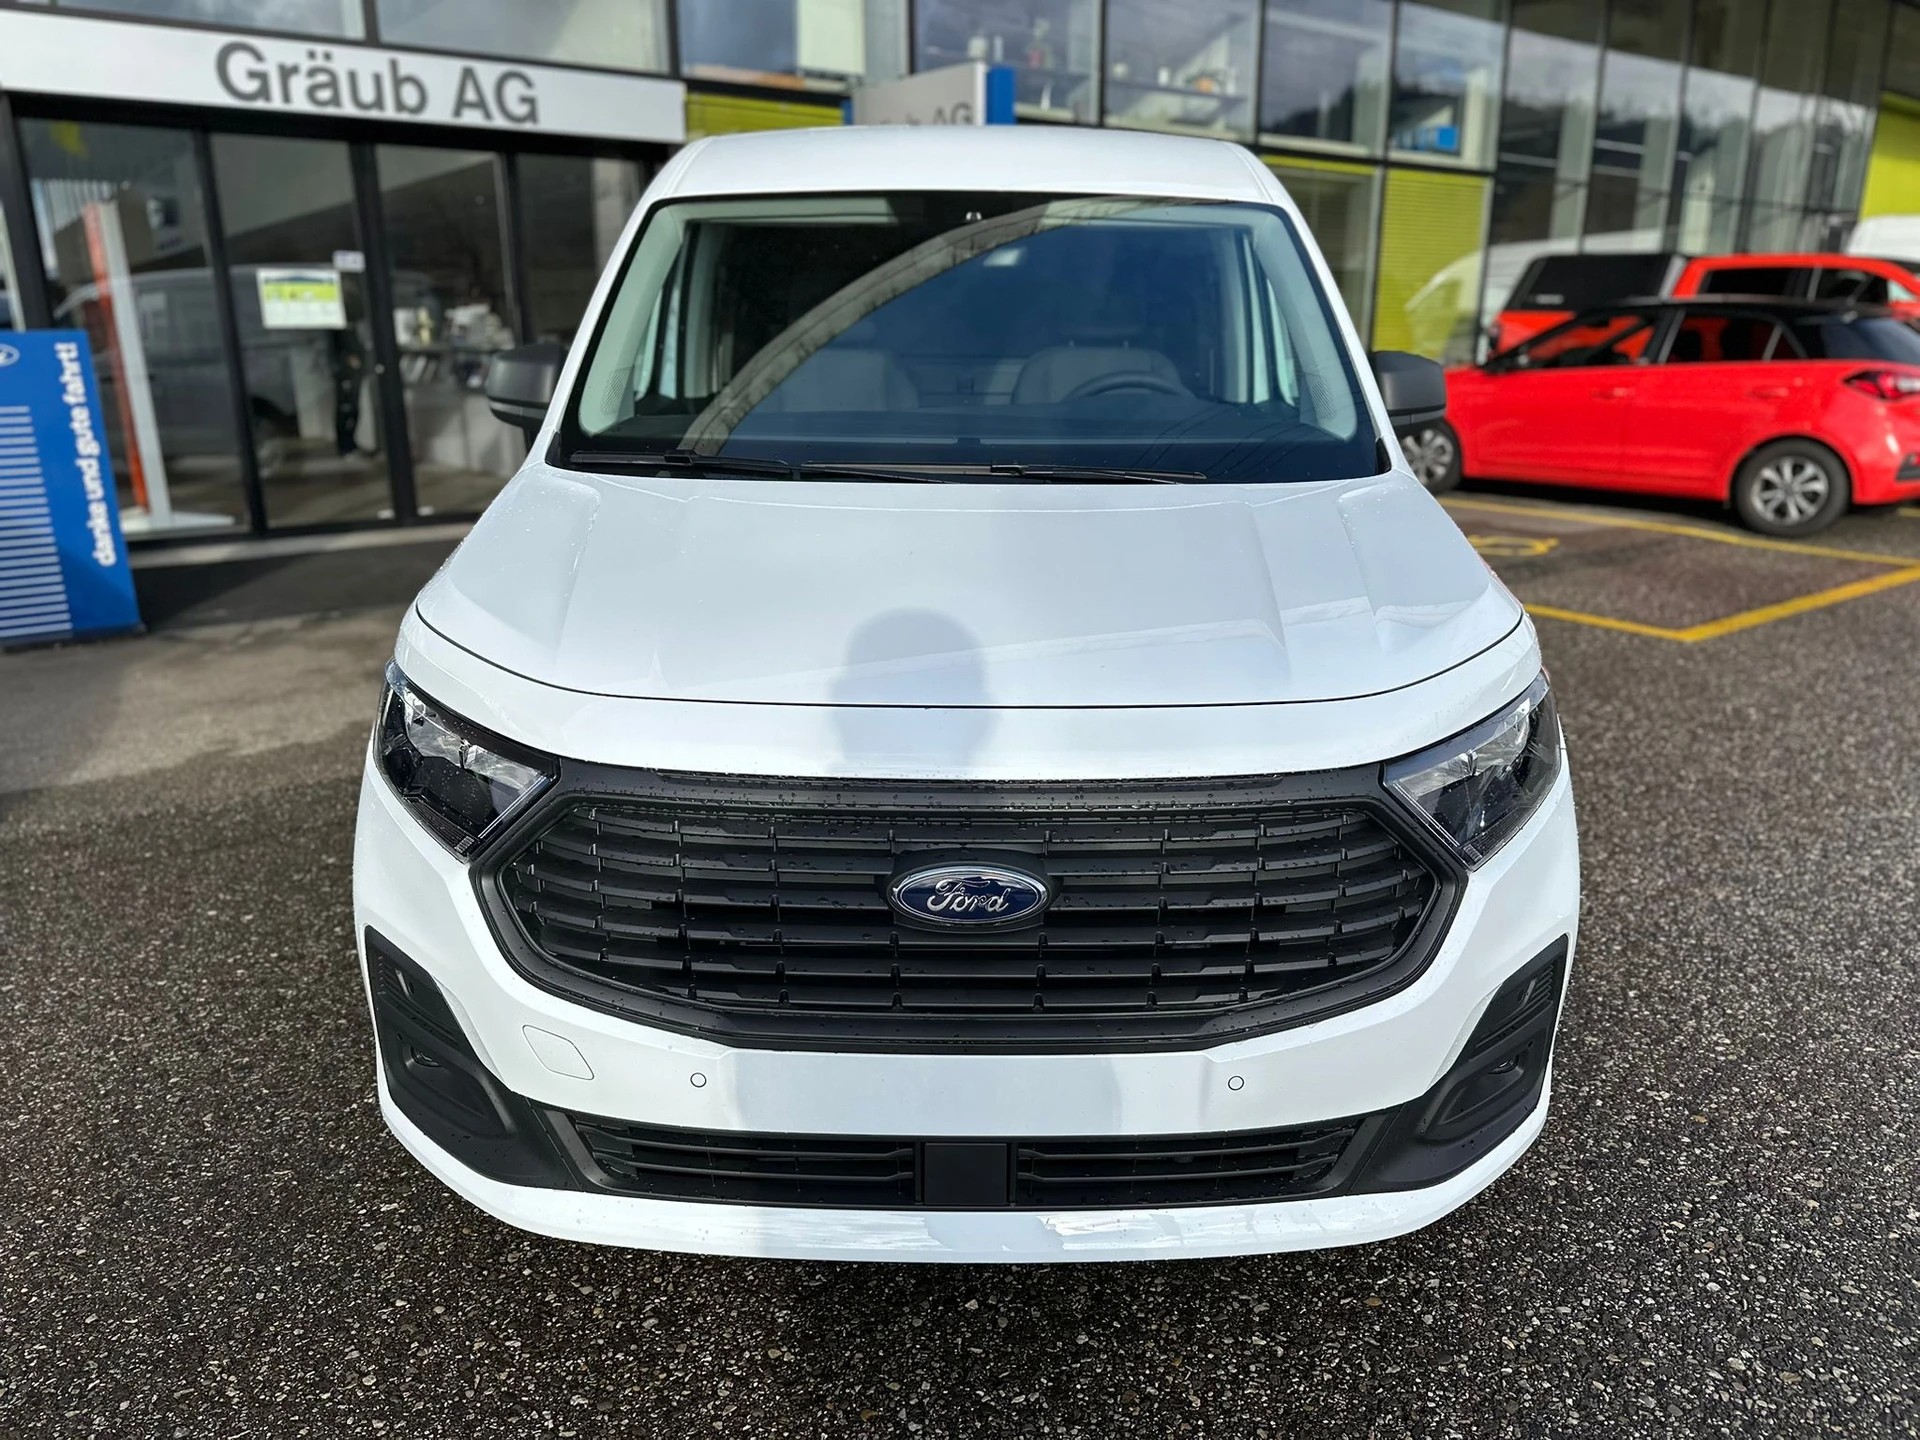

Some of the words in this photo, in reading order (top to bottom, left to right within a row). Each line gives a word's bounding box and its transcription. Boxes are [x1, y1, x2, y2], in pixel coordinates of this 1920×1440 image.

[215, 41, 427, 116] Gräub
[453, 66, 539, 124] AG
[54, 342, 87, 405] fahrt!
[69, 405, 101, 456] gute
[75, 458, 105, 500] und
[86, 501, 117, 567] danke
[926, 877, 1011, 913] Ford
